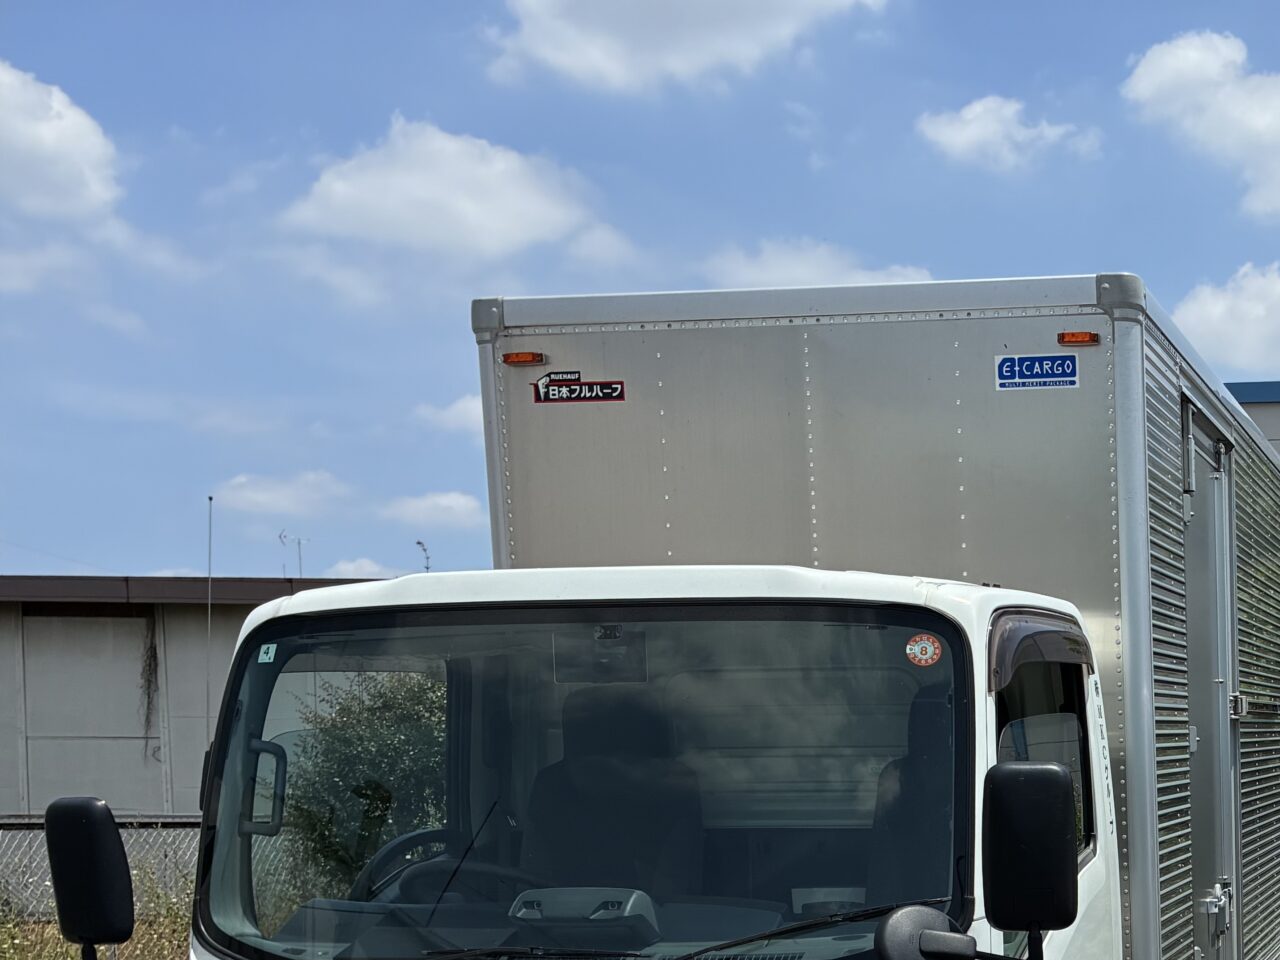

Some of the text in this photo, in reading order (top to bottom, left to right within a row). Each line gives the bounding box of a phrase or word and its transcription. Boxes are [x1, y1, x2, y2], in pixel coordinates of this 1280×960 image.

[1003, 360, 1073, 376] E-CARGO
[549, 384, 622, 399] 日本フルハーフ
